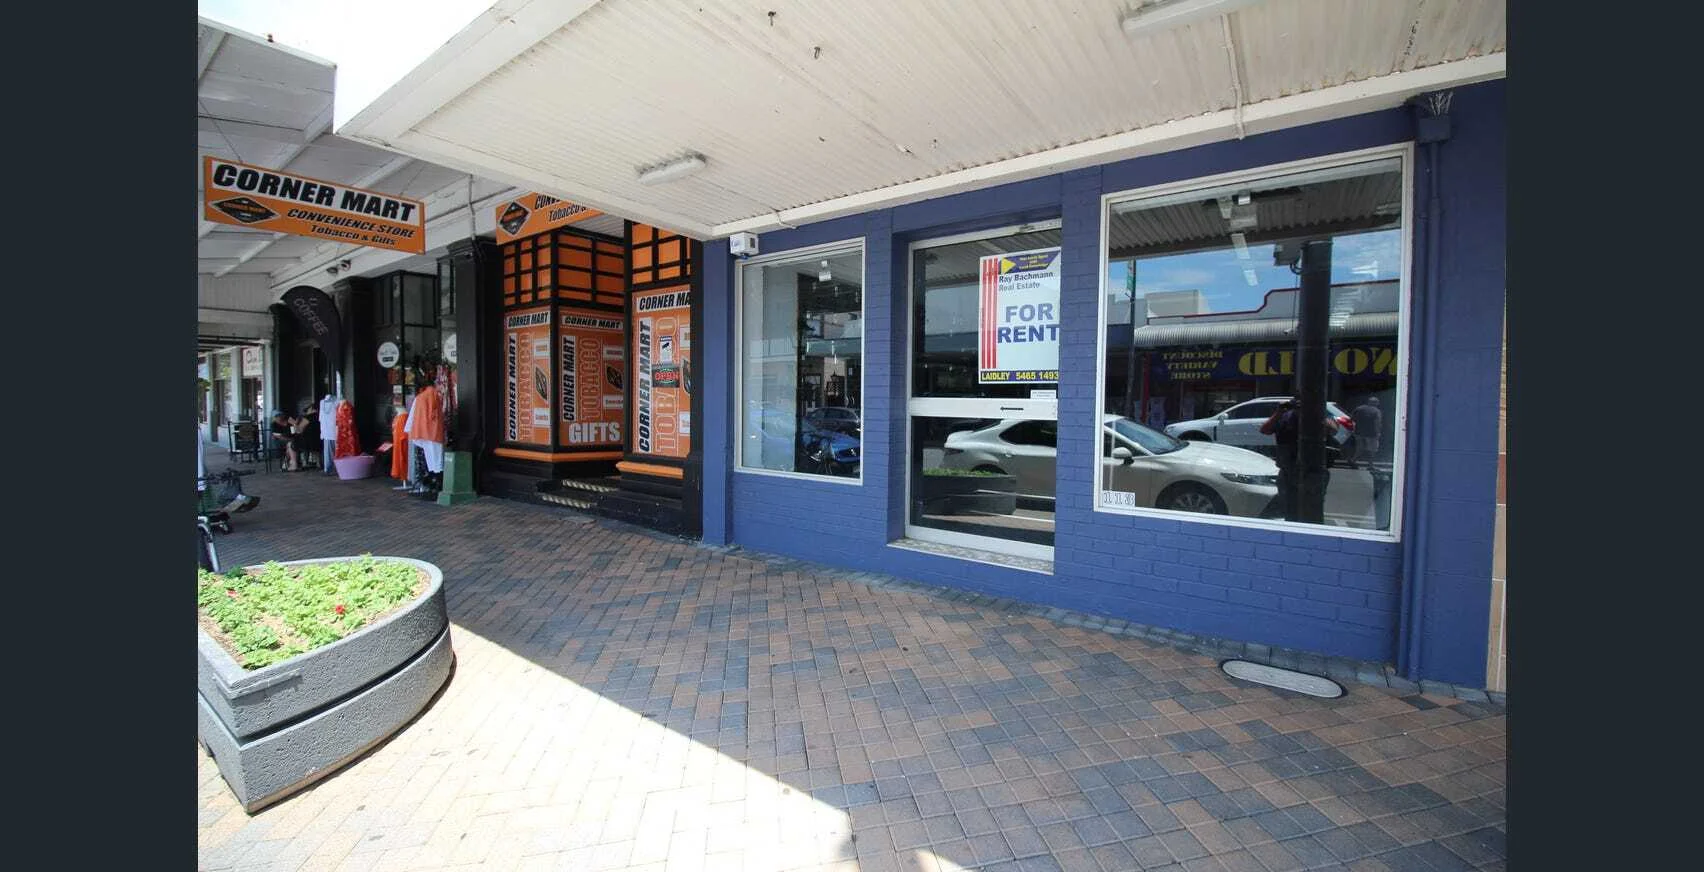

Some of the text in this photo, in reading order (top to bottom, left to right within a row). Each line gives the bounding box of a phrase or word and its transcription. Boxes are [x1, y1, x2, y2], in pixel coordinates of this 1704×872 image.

[213, 163, 416, 222] CORNER MART
[287, 208, 415, 238] CONVENIENCE STORE
[310, 224, 360, 240] Tobacco
[371, 234, 398, 246] Gifts
[999, 274, 1013, 284] Ray
[1014, 271, 1053, 281] Bachmann
[999, 281, 1041, 292] Real Estate
[639, 293, 675, 311] CORNER
[293, 297, 329, 336] COFFEE
[508, 311, 549, 328] CORNER MART
[565, 316, 620, 329] CORNER MART
[1006, 303, 1054, 322] FOR
[998, 324, 1060, 343] RENT
[563, 337, 575, 421] CORNER MART
[982, 371, 1059, 381] LAIDLEY 5465 1493
[509, 337, 517, 440] CORNER MART
[639, 320, 651, 453] CORNER MART
[568, 422, 621, 443] GIFTS
